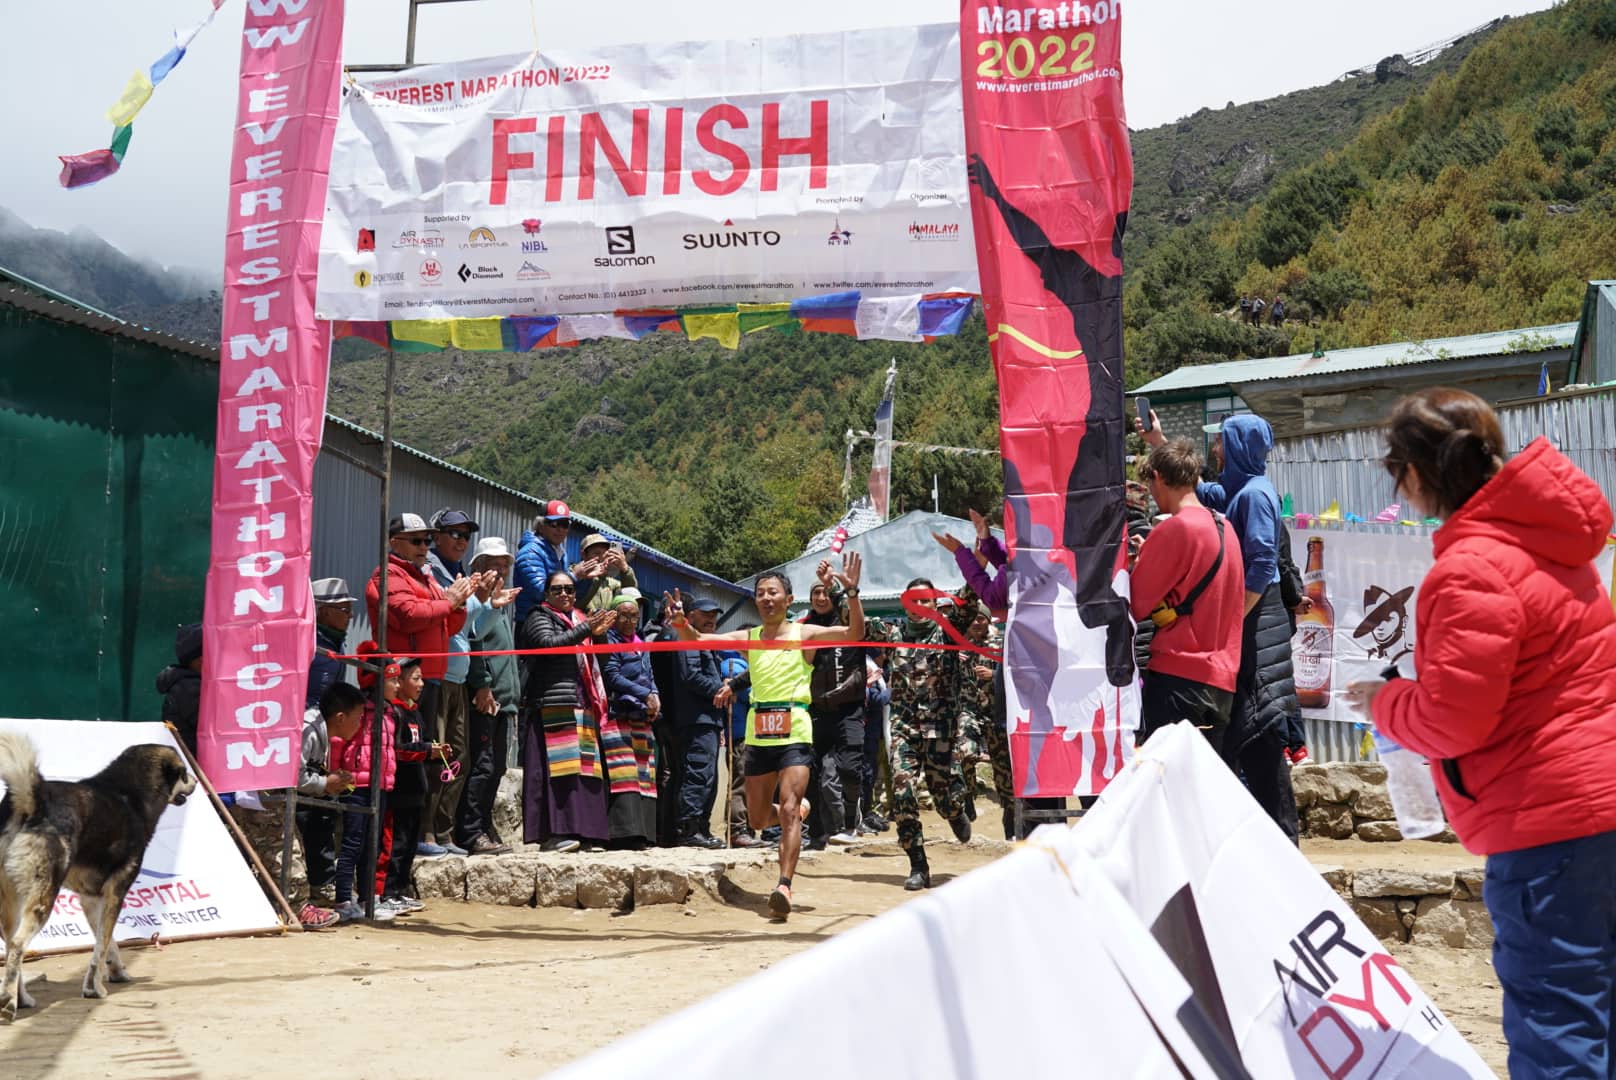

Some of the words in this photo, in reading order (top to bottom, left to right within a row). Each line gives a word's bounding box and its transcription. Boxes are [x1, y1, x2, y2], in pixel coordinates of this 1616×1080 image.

[976, 32, 1096, 78] 2022
[461, 66, 559, 98] MARATHON
[562, 64, 610, 82] 2022
[489, 99, 829, 205] FINISH
[424, 215, 459, 224] Supported
[462, 213, 471, 222] by
[399, 237, 445, 245] DYNASTY
[521, 240, 548, 252] NIBL
[682, 230, 781, 250] SUUNTO
[478, 265, 498, 273] Black
[594, 255, 656, 268] salomon
[472, 272, 504, 280] Diamond
[558, 291, 587, 301] Contact
[760, 713, 784, 732] 182
[120, 879, 211, 910] SPITAL
[1273, 909, 1367, 1027] AIR
